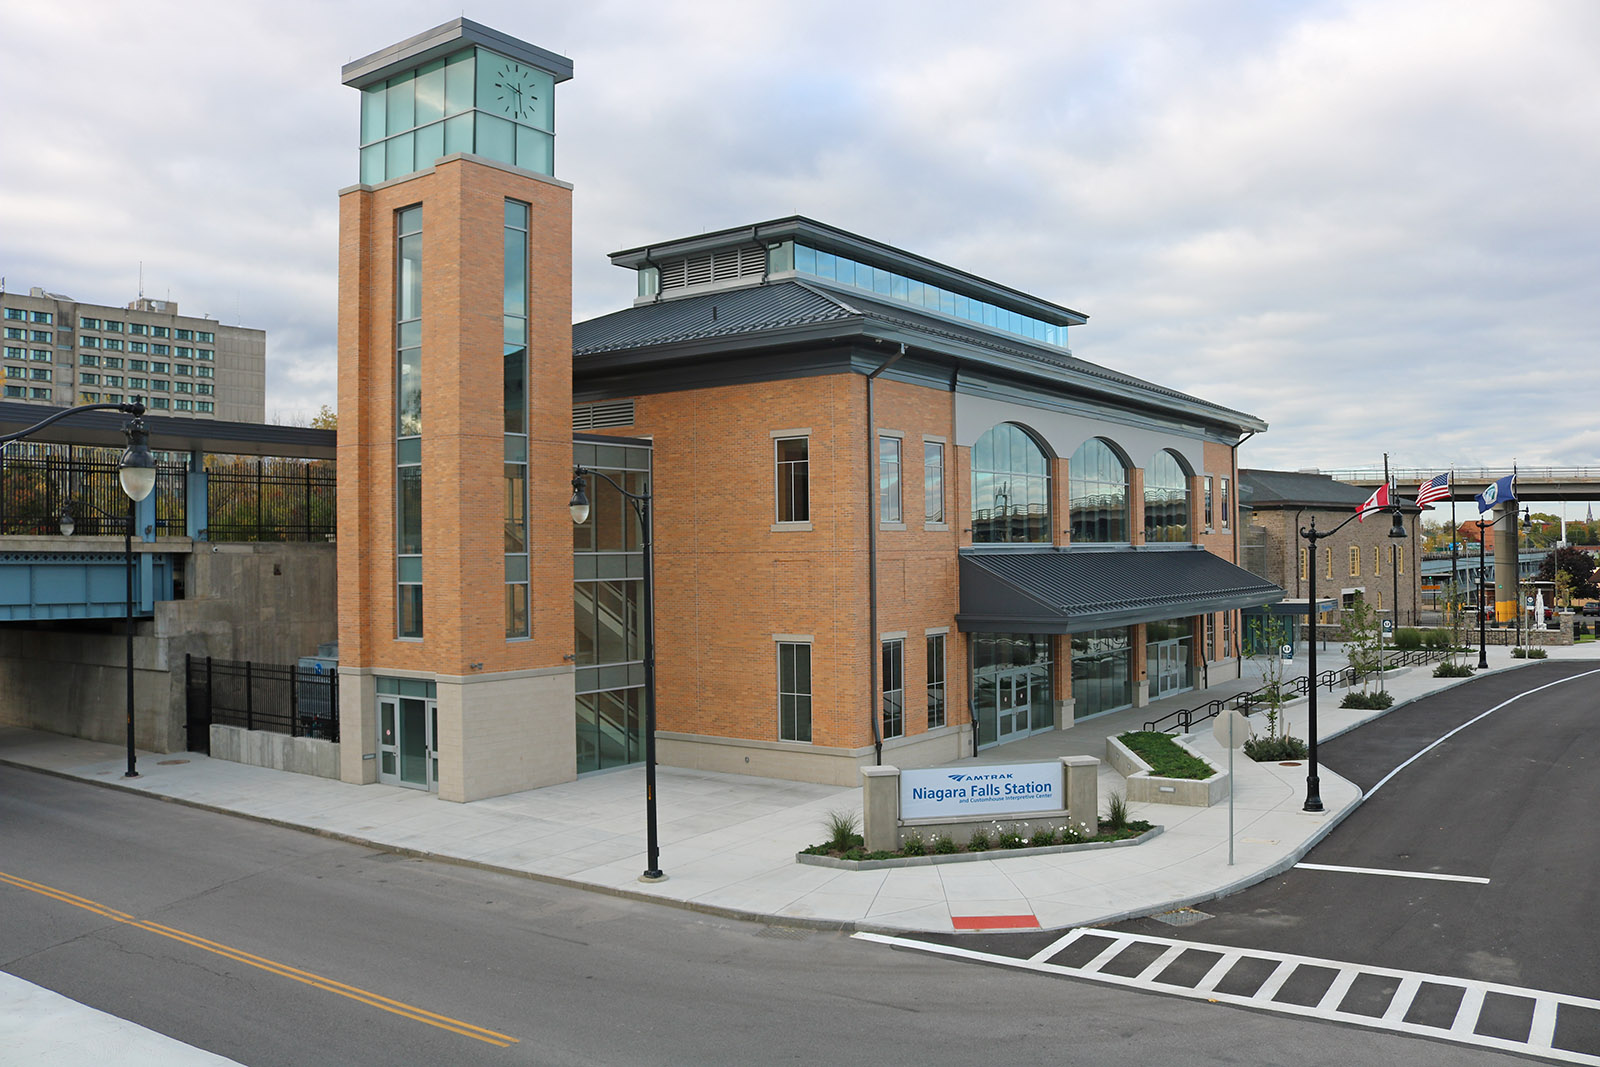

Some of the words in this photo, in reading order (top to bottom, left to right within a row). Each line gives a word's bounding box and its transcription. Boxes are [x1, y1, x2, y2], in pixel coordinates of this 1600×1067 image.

[913, 787, 966, 801] Niagara
[971, 784, 1000, 797] Falls
[1004, 781, 1052, 795] Station
